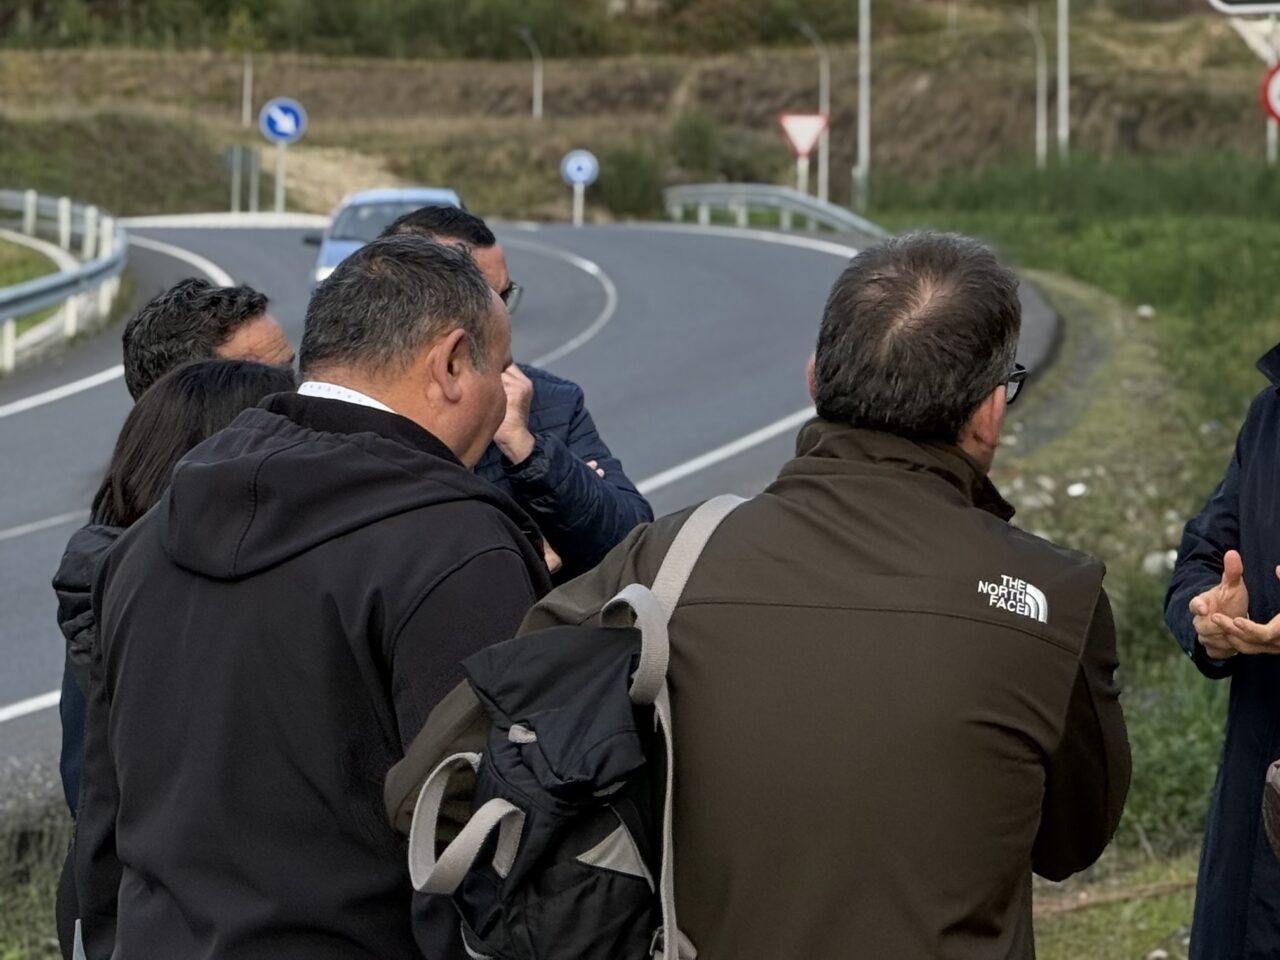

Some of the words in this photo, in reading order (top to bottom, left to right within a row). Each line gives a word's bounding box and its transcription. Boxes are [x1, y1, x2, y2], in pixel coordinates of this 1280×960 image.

[977, 580, 1026, 604] NORTH
[1000, 574, 1026, 592] THE
[989, 595, 1025, 615] FACE
